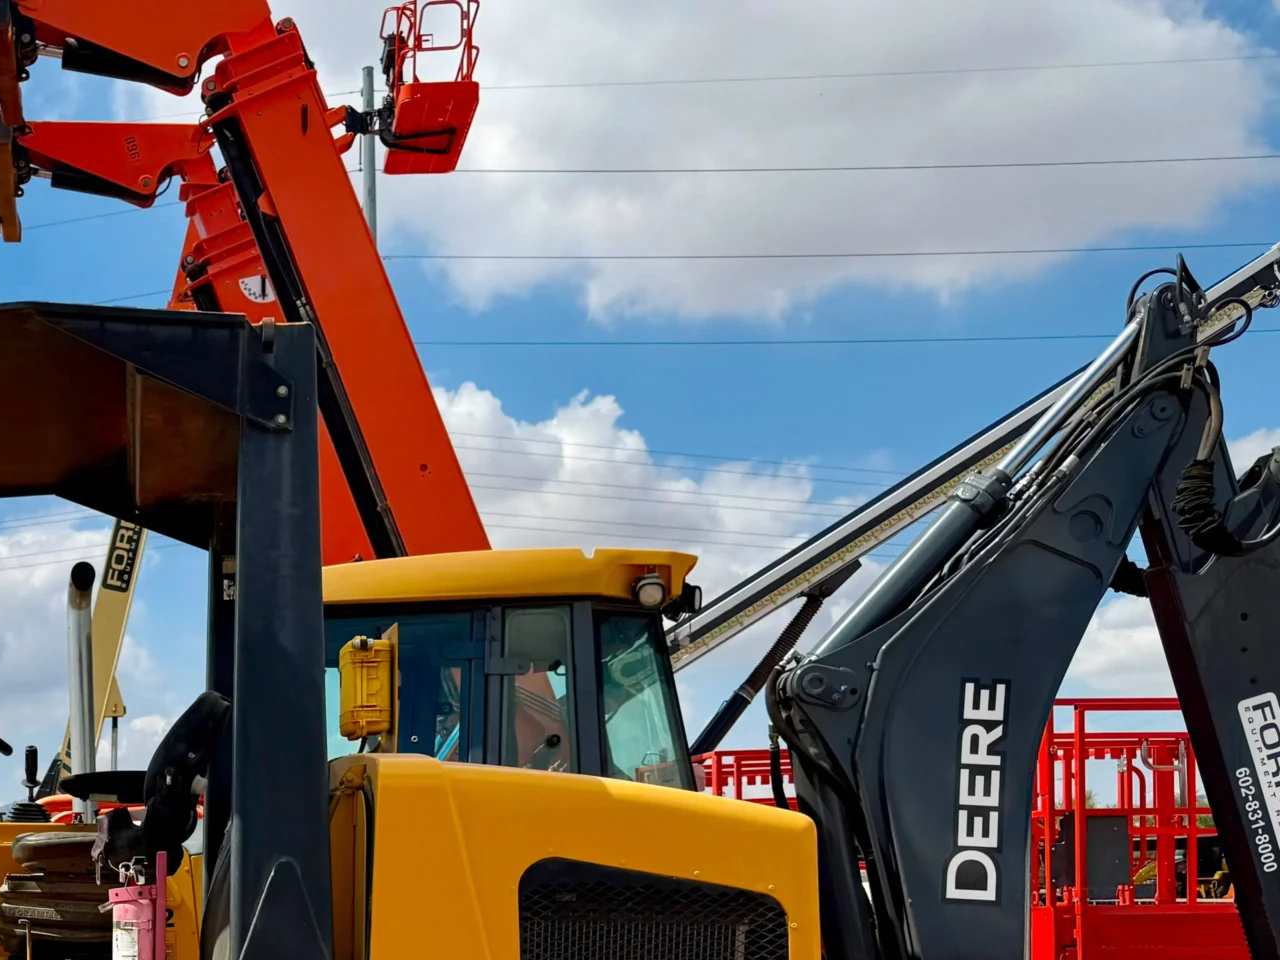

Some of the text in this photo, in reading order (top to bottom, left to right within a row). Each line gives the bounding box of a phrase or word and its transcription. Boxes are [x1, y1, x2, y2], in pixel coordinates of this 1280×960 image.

[946, 682, 1007, 901] DEERE
[1244, 706, 1277, 798] EQUIPMENT
[1251, 700, 1280, 787] FOR
[1235, 767, 1277, 873] 602-831-8000
